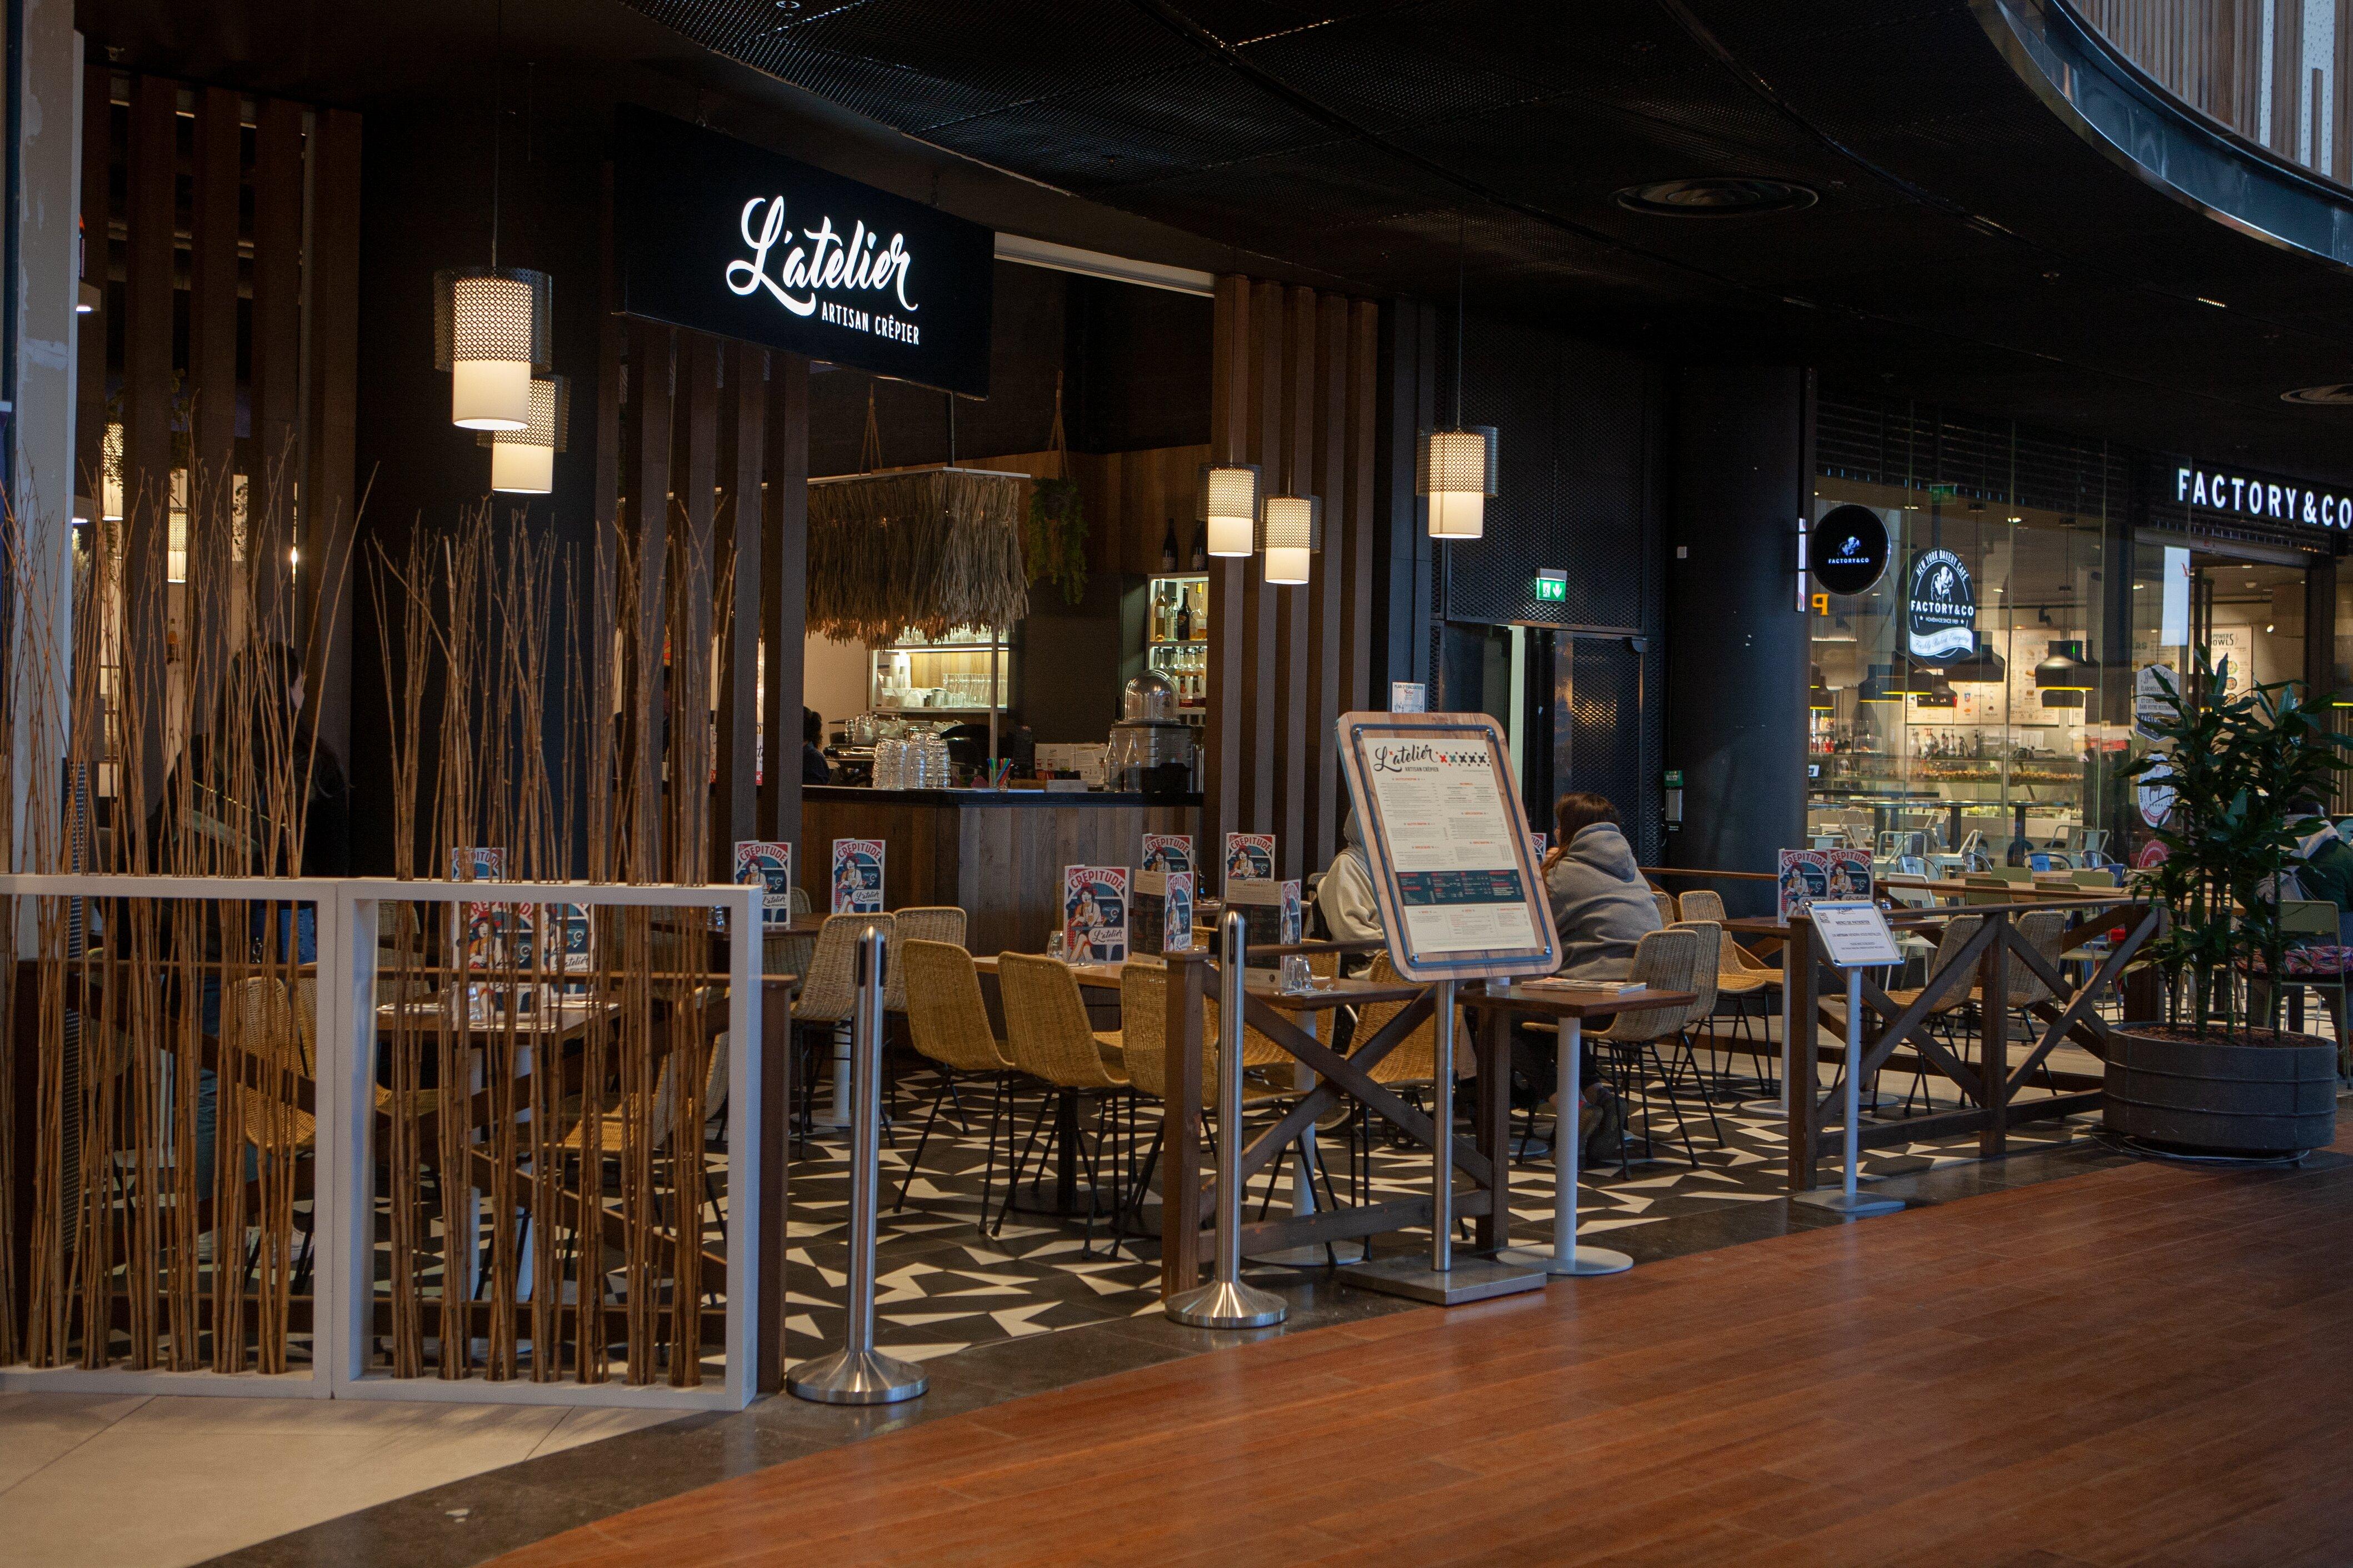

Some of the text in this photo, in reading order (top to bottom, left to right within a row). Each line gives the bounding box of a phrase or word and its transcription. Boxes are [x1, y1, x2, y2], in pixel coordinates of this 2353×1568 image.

[726, 196, 918, 316] L'atelier
[822, 302, 919, 345] ARTISAN CRÊPIER
[2178, 467, 2353, 529] FACTORY&CO
[1916, 549, 1970, 582] NEW YORK BAKERY CAFÉ
[1910, 600, 1974, 617] FACTORY&CO
[2211, 633, 2234, 646] OWLS
[1373, 744, 1438, 773] L'atelier
[1092, 928, 1123, 943] L'atelier
